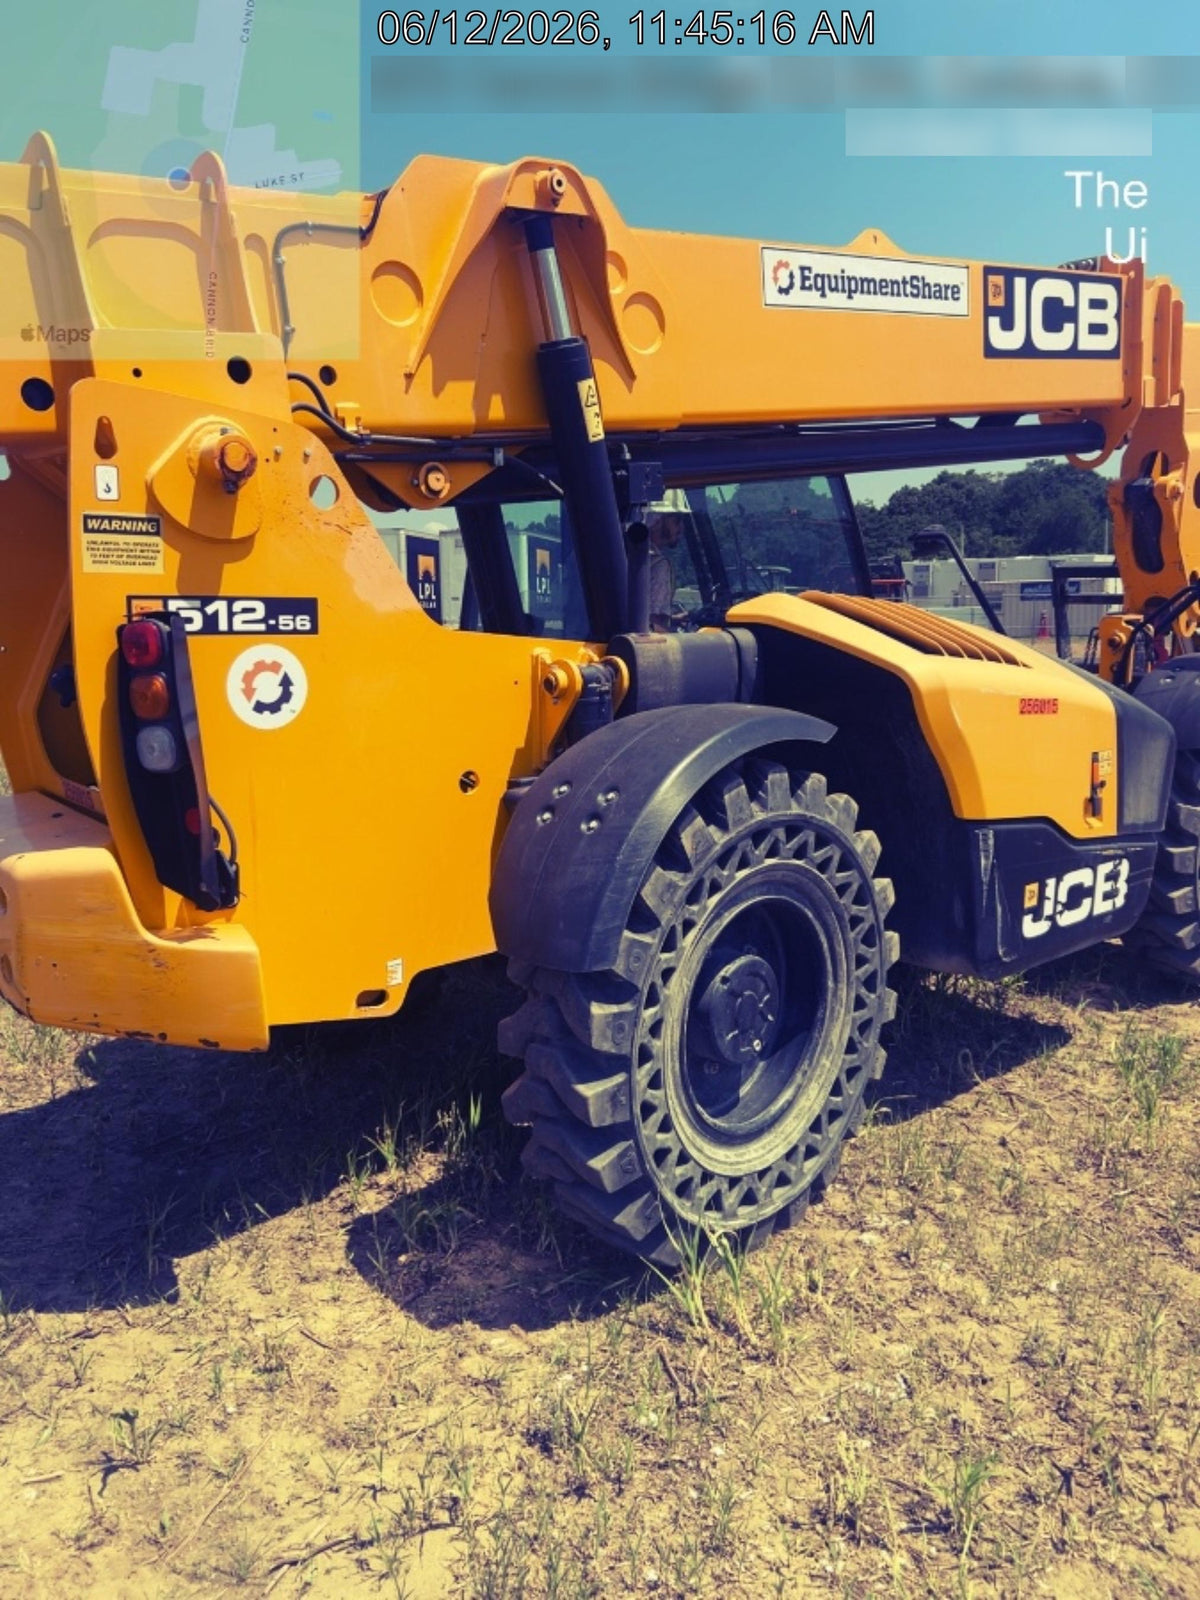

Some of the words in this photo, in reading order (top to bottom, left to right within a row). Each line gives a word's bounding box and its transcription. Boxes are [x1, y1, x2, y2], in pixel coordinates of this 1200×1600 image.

[799, 265, 961, 302] EquipmentShare
[988, 276, 1119, 351] JCB
[86, 518, 158, 533] WARNING
[418, 582, 436, 600] LPL
[167, 599, 311, 632] 512-56
[1022, 858, 1130, 938] JCB
